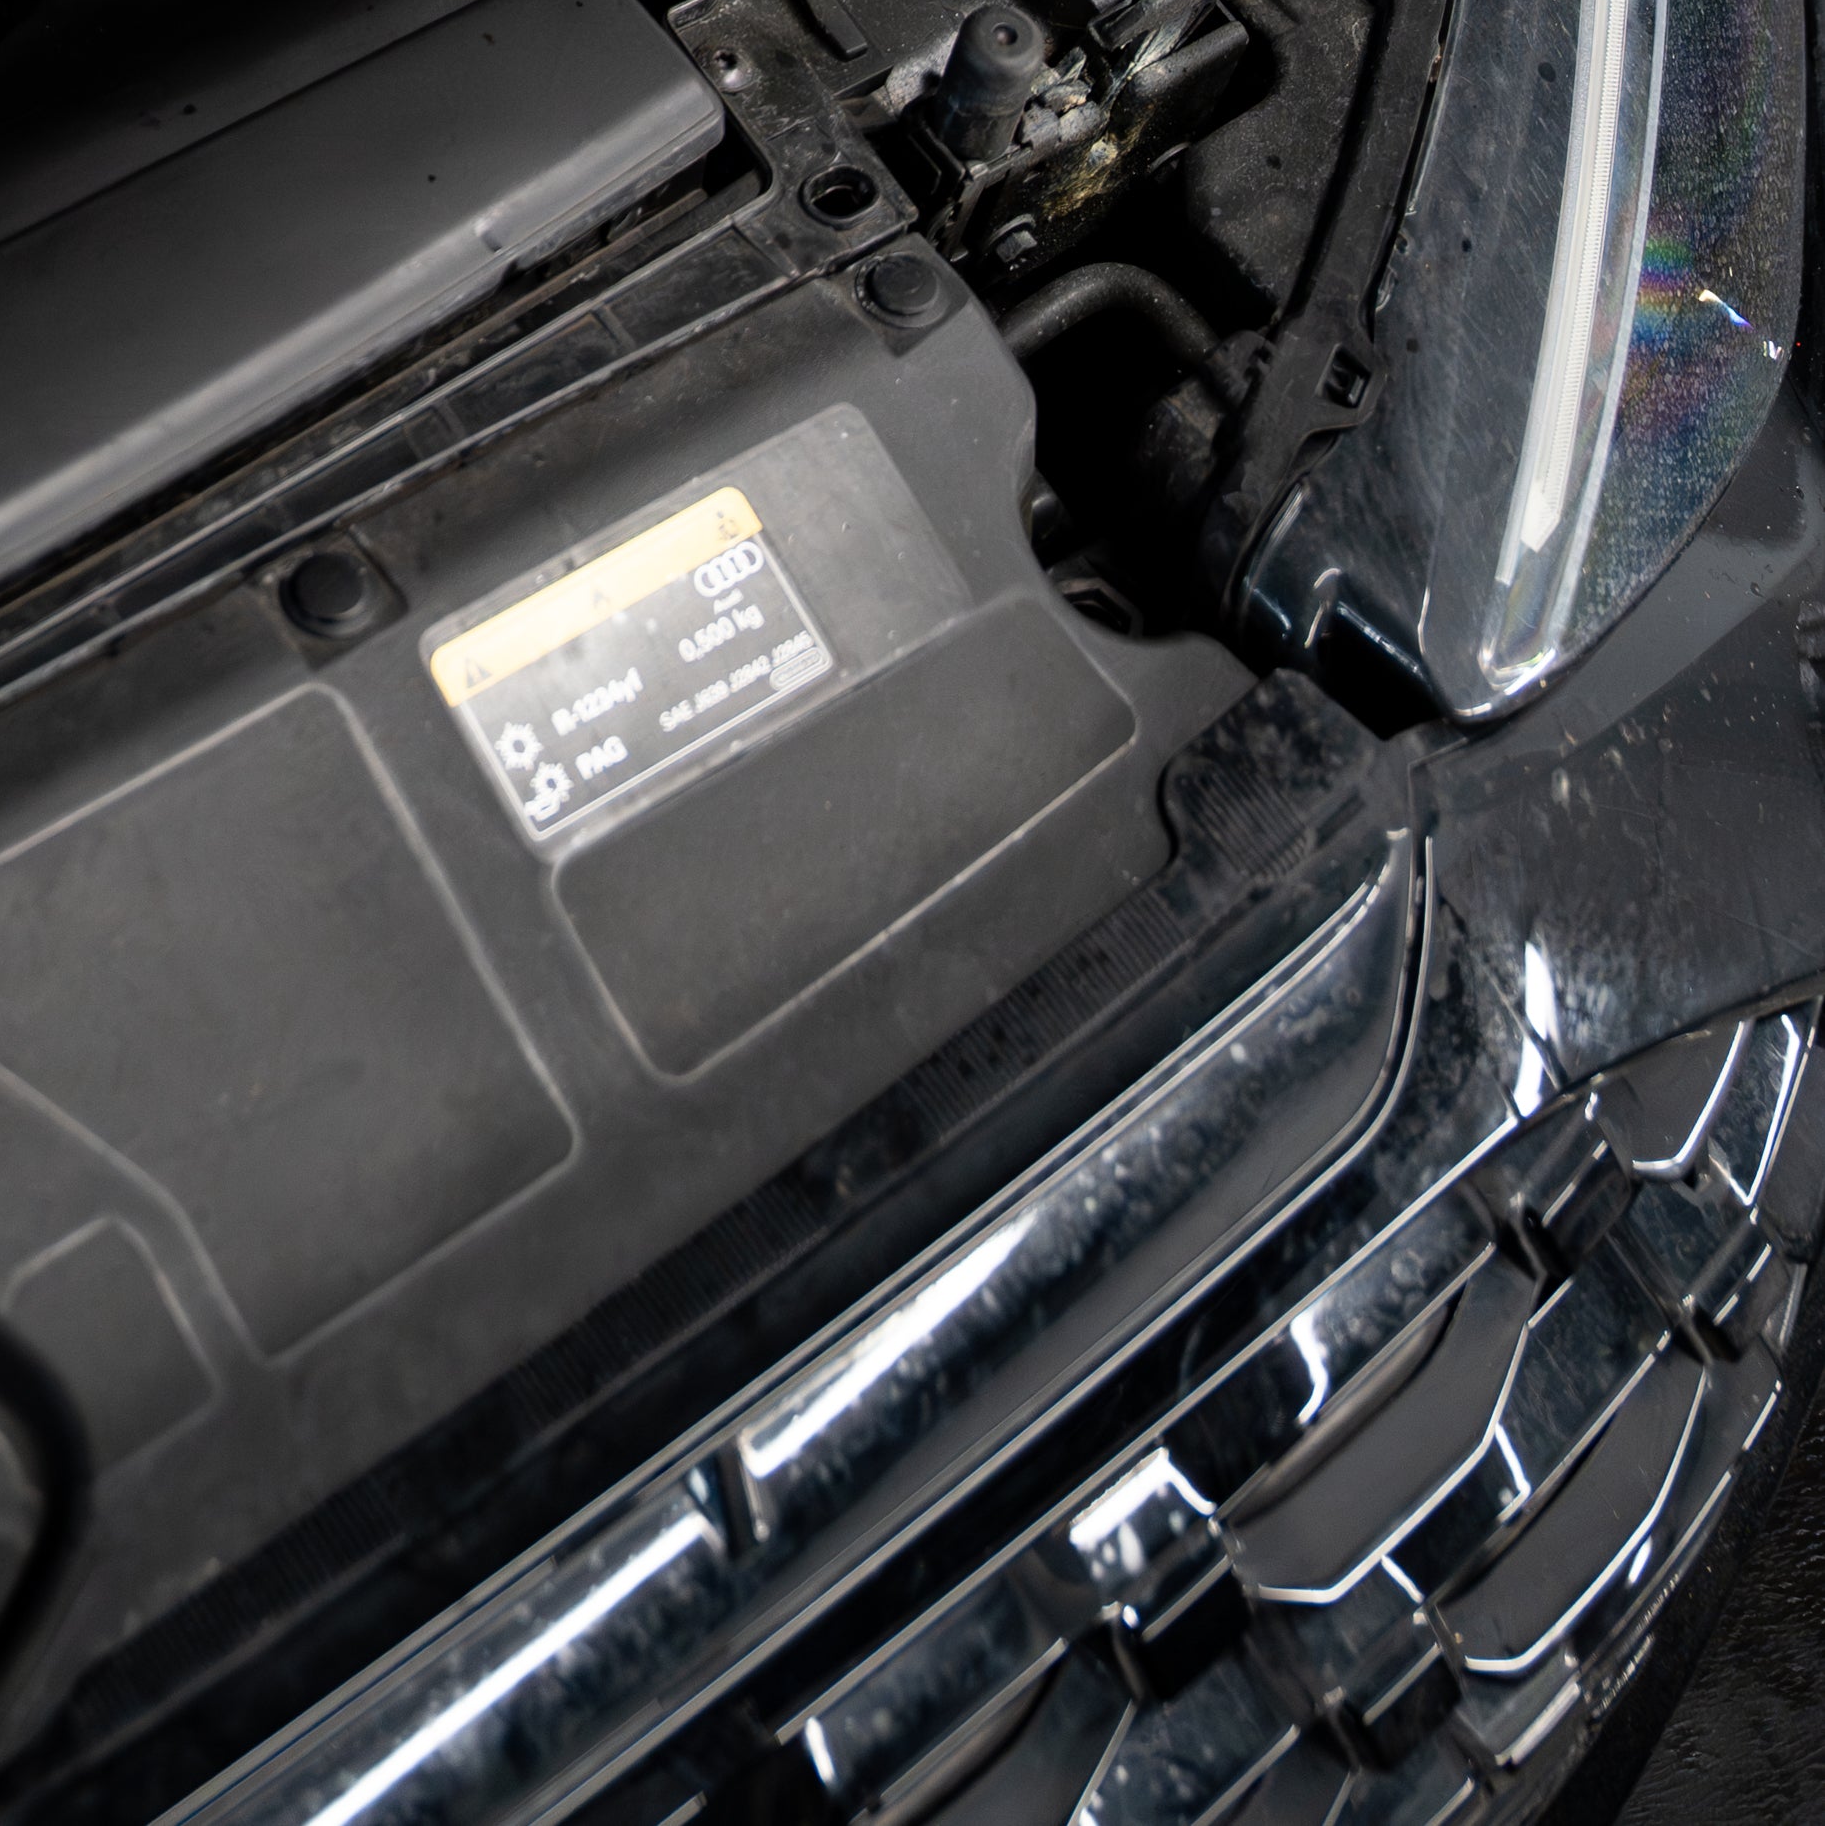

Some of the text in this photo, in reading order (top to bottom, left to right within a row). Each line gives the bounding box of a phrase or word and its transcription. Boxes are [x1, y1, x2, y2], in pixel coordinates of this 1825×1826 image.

[736, 604, 765, 632] kg
[575, 735, 629, 781] PAG
[659, 700, 693, 733] SAE
